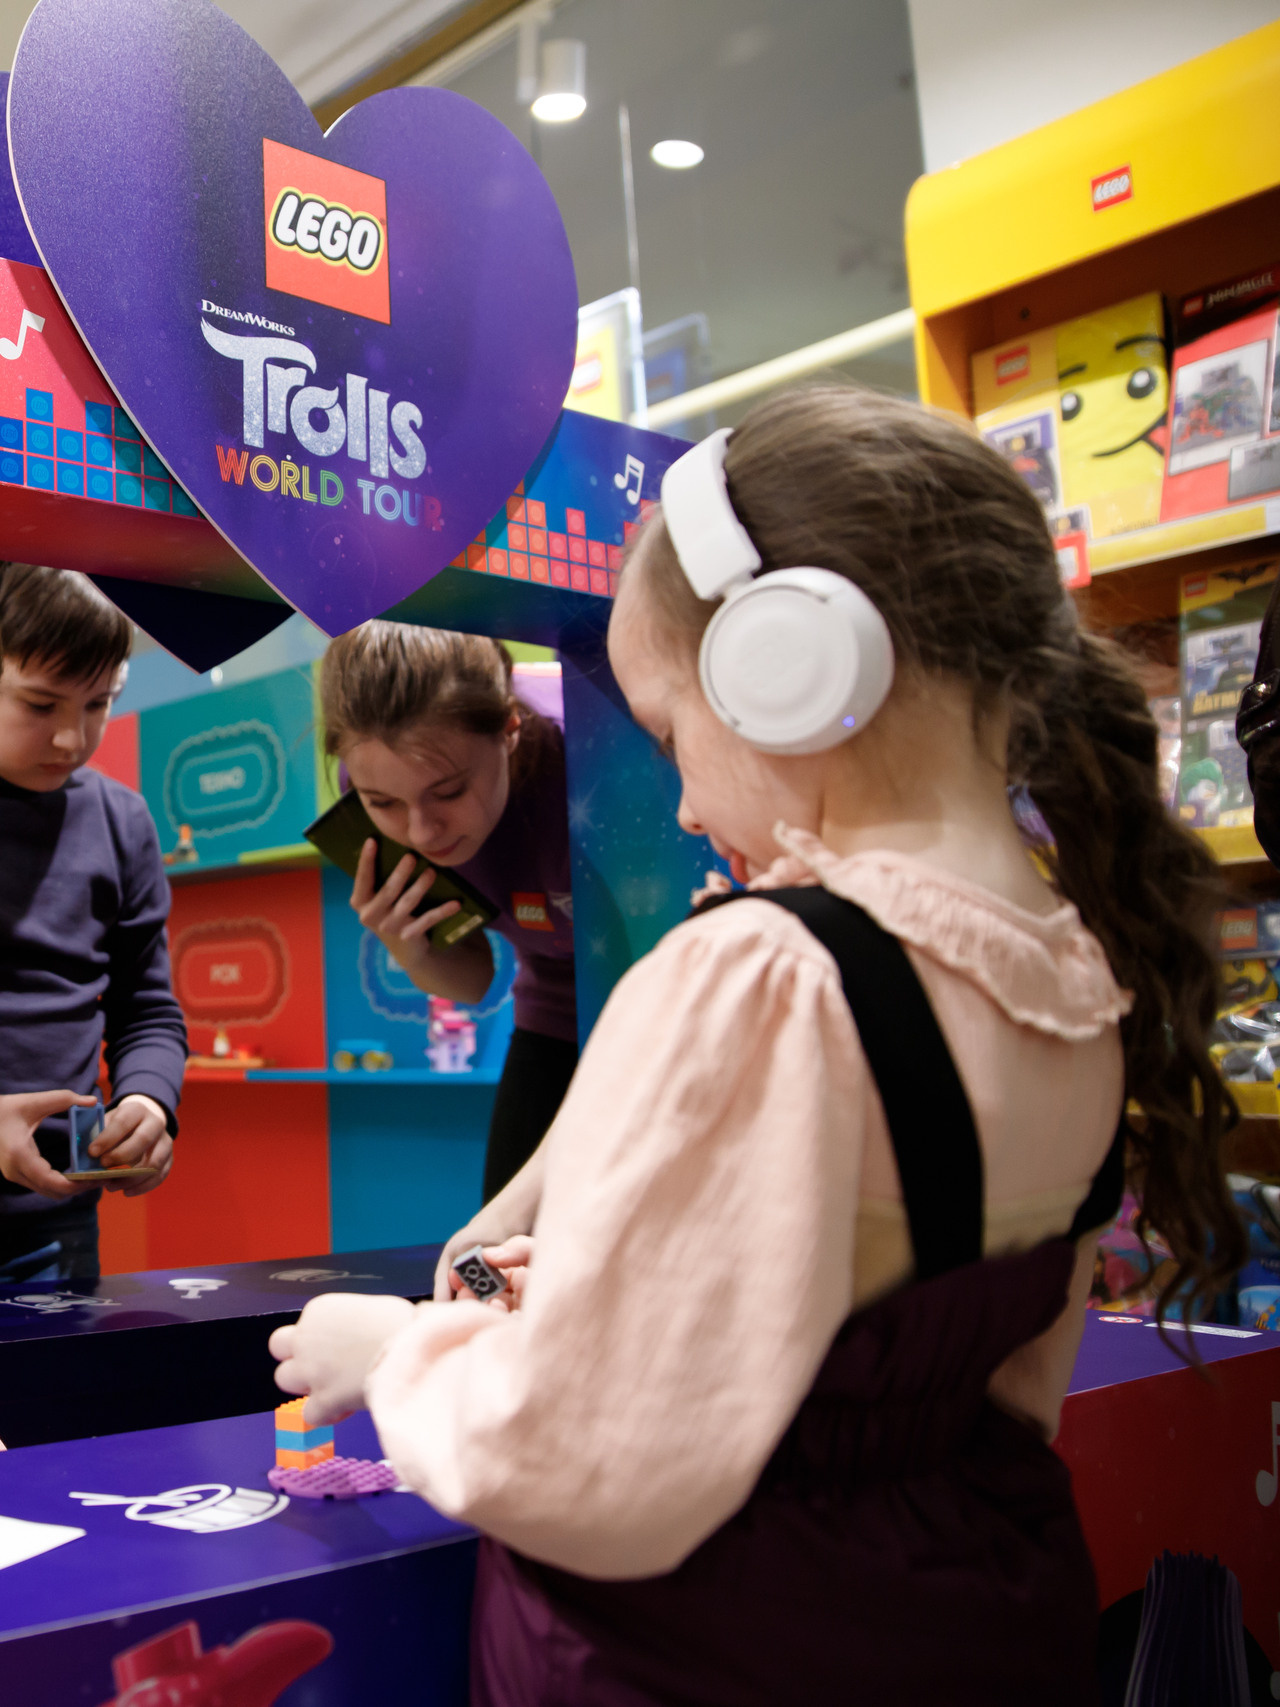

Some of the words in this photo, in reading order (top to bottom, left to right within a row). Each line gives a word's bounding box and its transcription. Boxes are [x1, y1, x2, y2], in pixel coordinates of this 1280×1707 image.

[1094, 174, 1130, 202] LEGO
[271, 188, 382, 272] LEGO
[216, 444, 344, 507] WORLD
[357, 478, 442, 532] TOUR
[516, 905, 546, 922] LEGO
